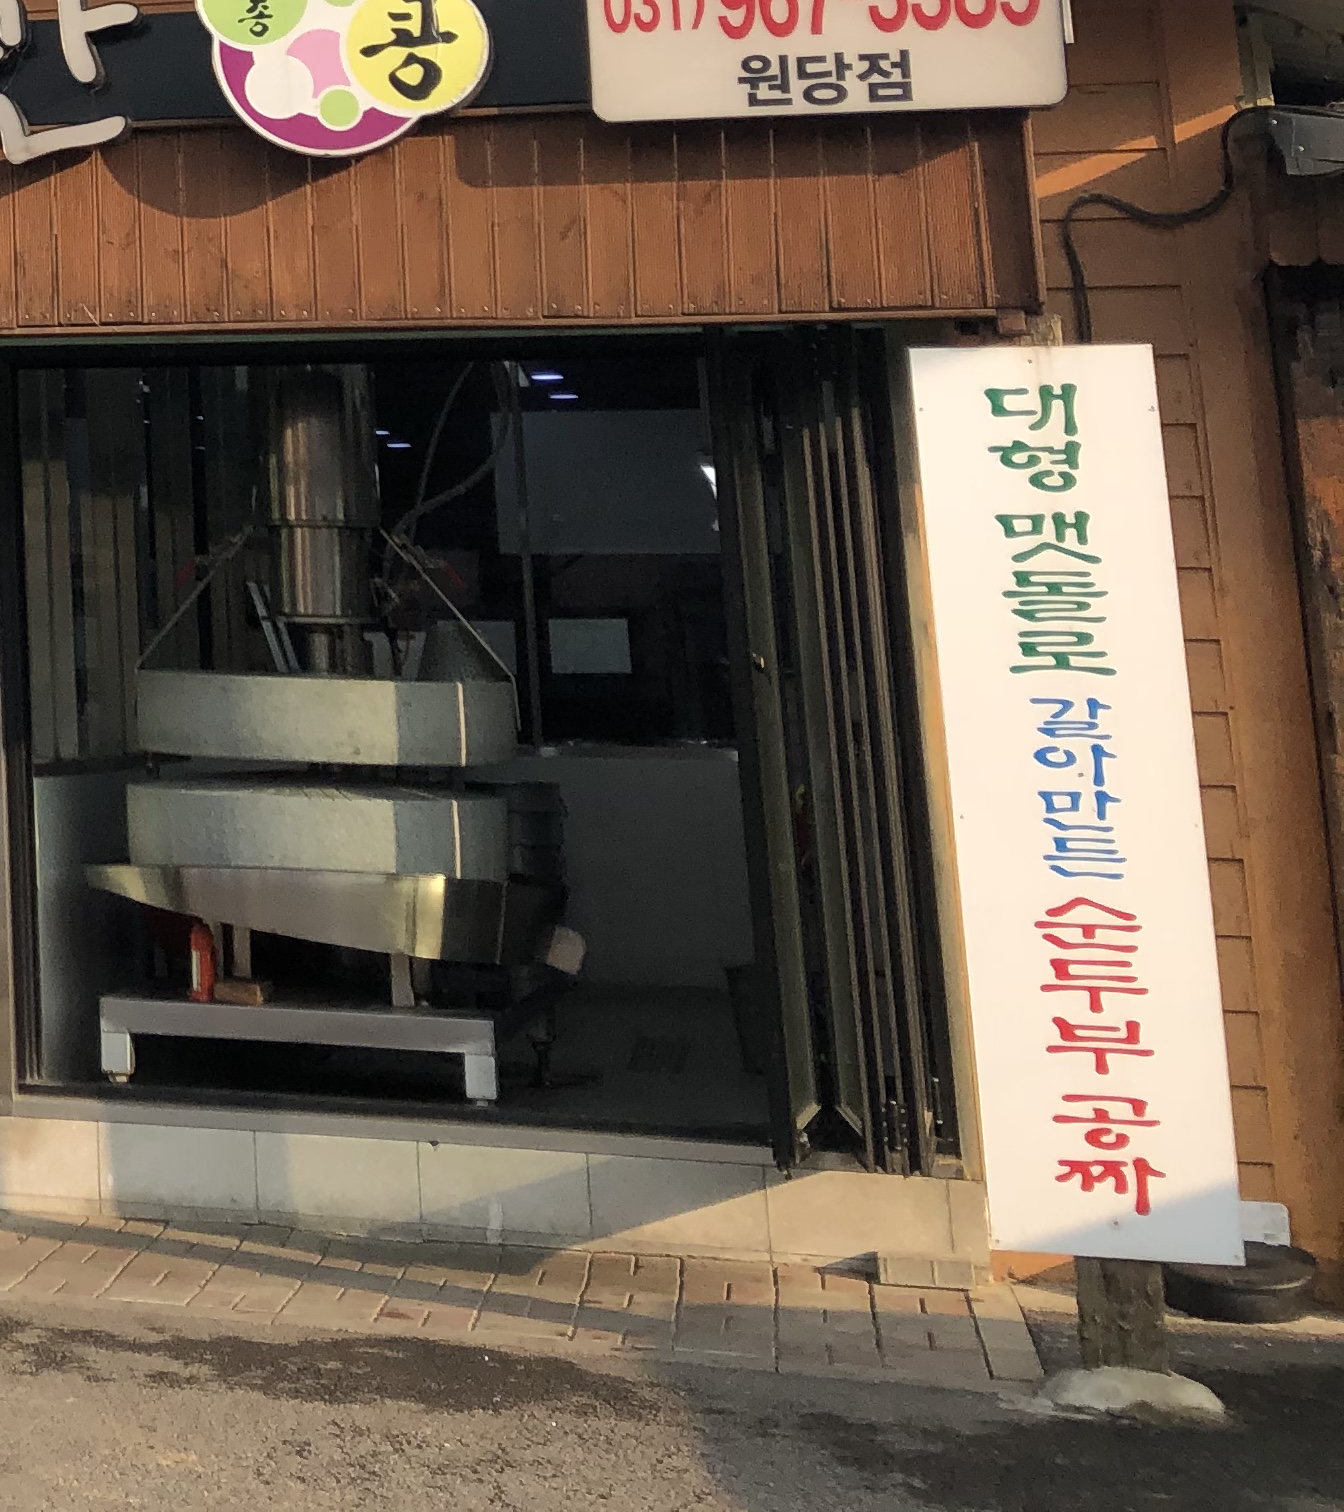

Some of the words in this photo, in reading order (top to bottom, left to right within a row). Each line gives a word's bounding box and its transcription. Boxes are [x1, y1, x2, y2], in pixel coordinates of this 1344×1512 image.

[736, 48, 914, 107] 원당점
[984, 383, 1082, 493] 대형
[995, 510, 1117, 676] 맷돌로
[1034, 897, 1154, 1075] 순두부
[1052, 1094, 1166, 1216] 공짜
